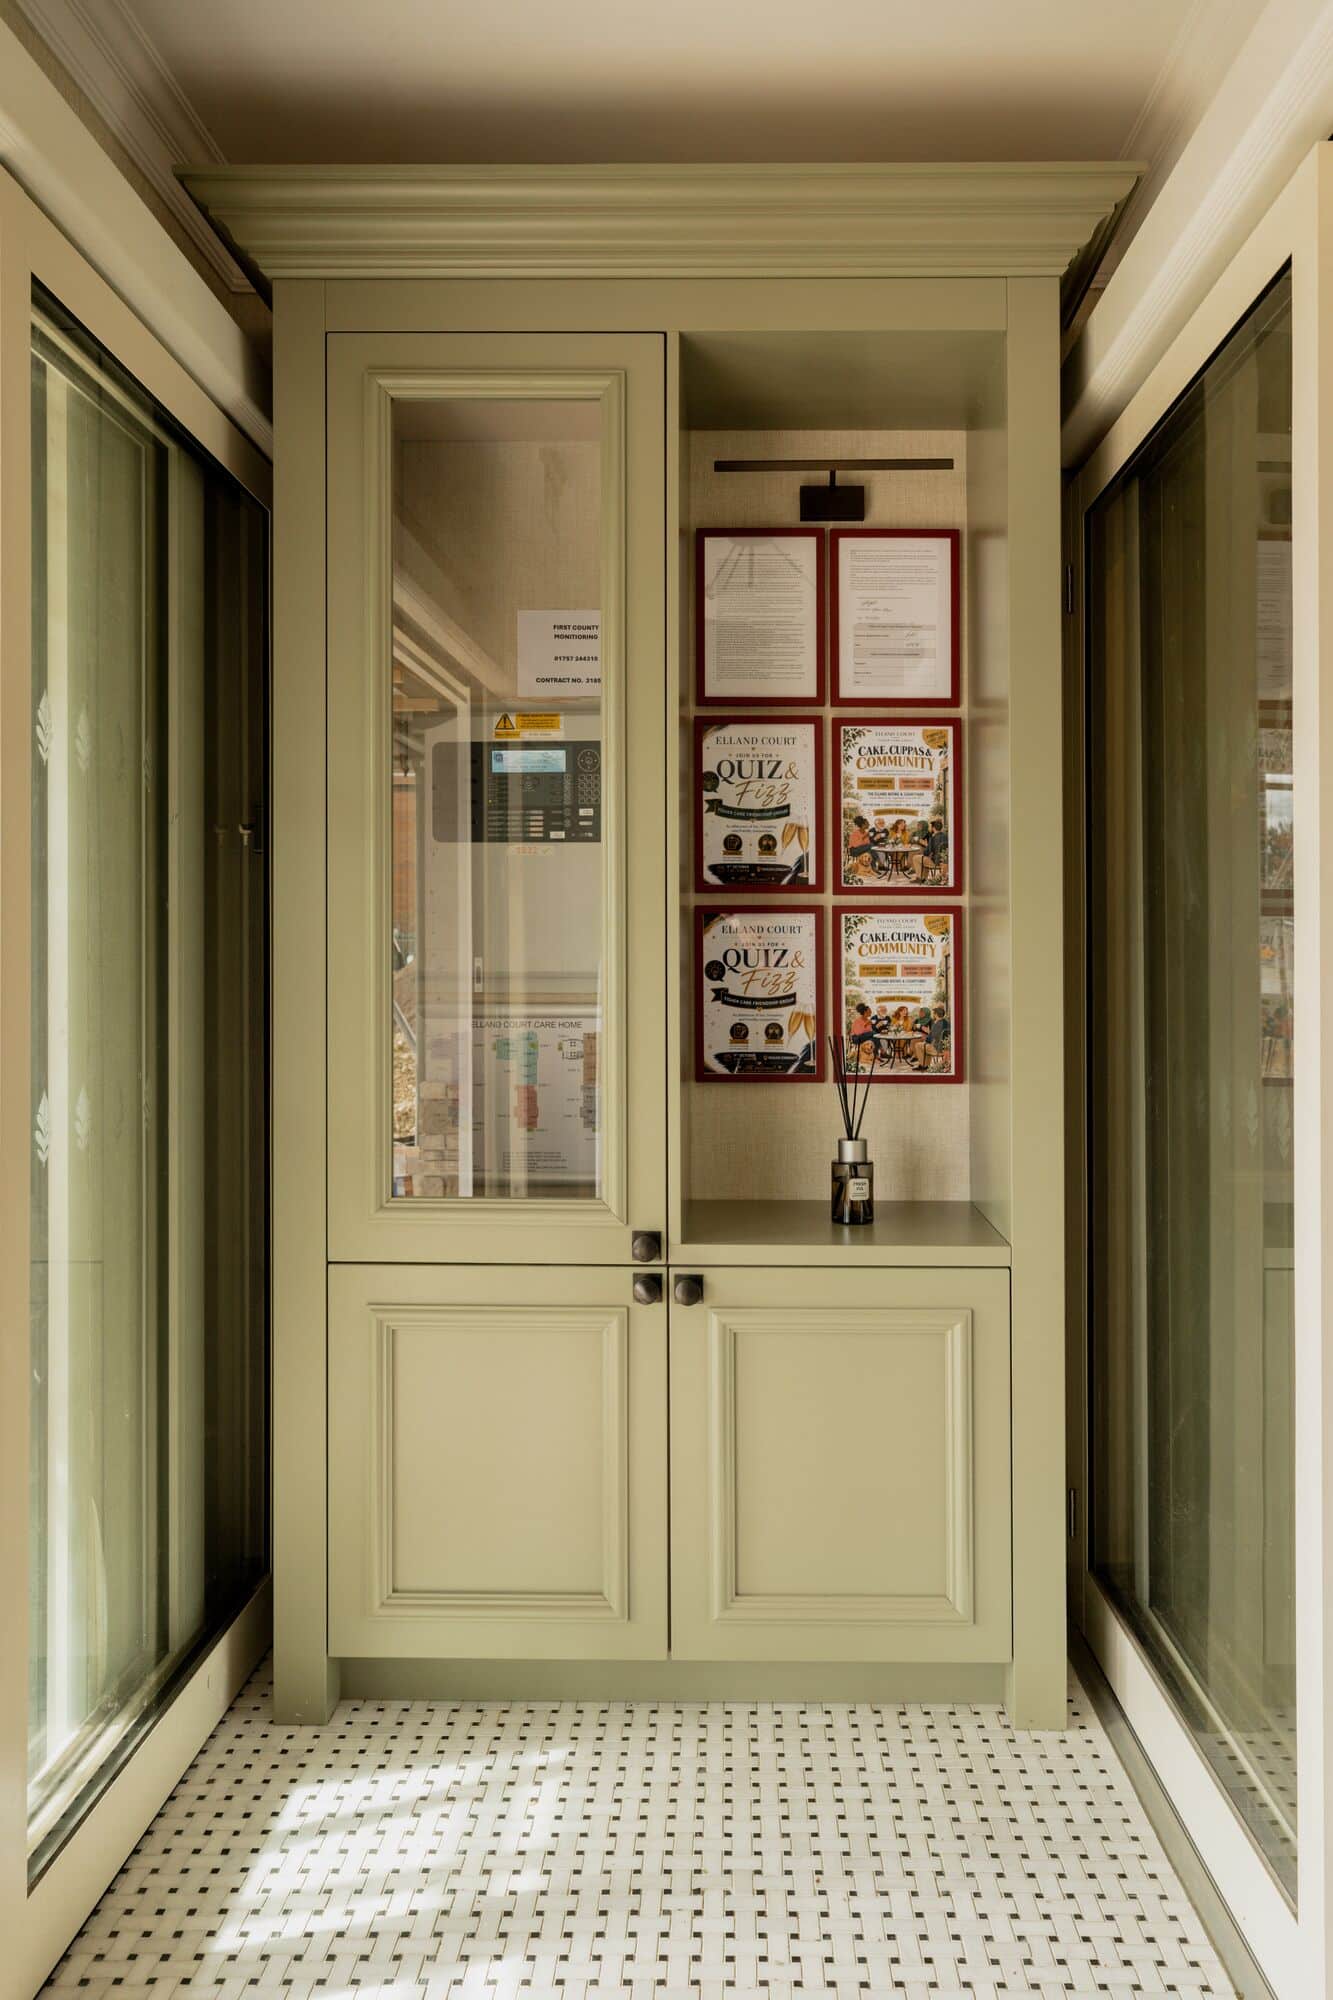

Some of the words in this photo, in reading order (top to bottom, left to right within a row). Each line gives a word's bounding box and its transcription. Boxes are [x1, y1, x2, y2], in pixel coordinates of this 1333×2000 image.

[715, 736, 758, 745] ELLAND
[761, 736, 797, 745] COURT
[889, 745, 925, 756] CUPPAS
[925, 748, 932, 757] &
[856, 756, 935, 771] COMMUNITY
[716, 759, 783, 784] QUIZ
[784, 761, 800, 780] &
[735, 779, 792, 807] Fizz
[721, 925, 764, 934] ELLAND
[767, 925, 802, 934] COURT
[891, 932, 927, 943] CUPPAS
[857, 943, 937, 958] COMMUNITY
[722, 948, 789, 974] QUIZ
[790, 950, 806, 968] &
[740, 968, 799, 996] Fizz
[472, 1020, 501, 1029] ELLAND
[503, 1020, 532, 1029] COURT
[534, 1020, 557, 1029] CARE
[558, 1020, 583, 1029] HOME
